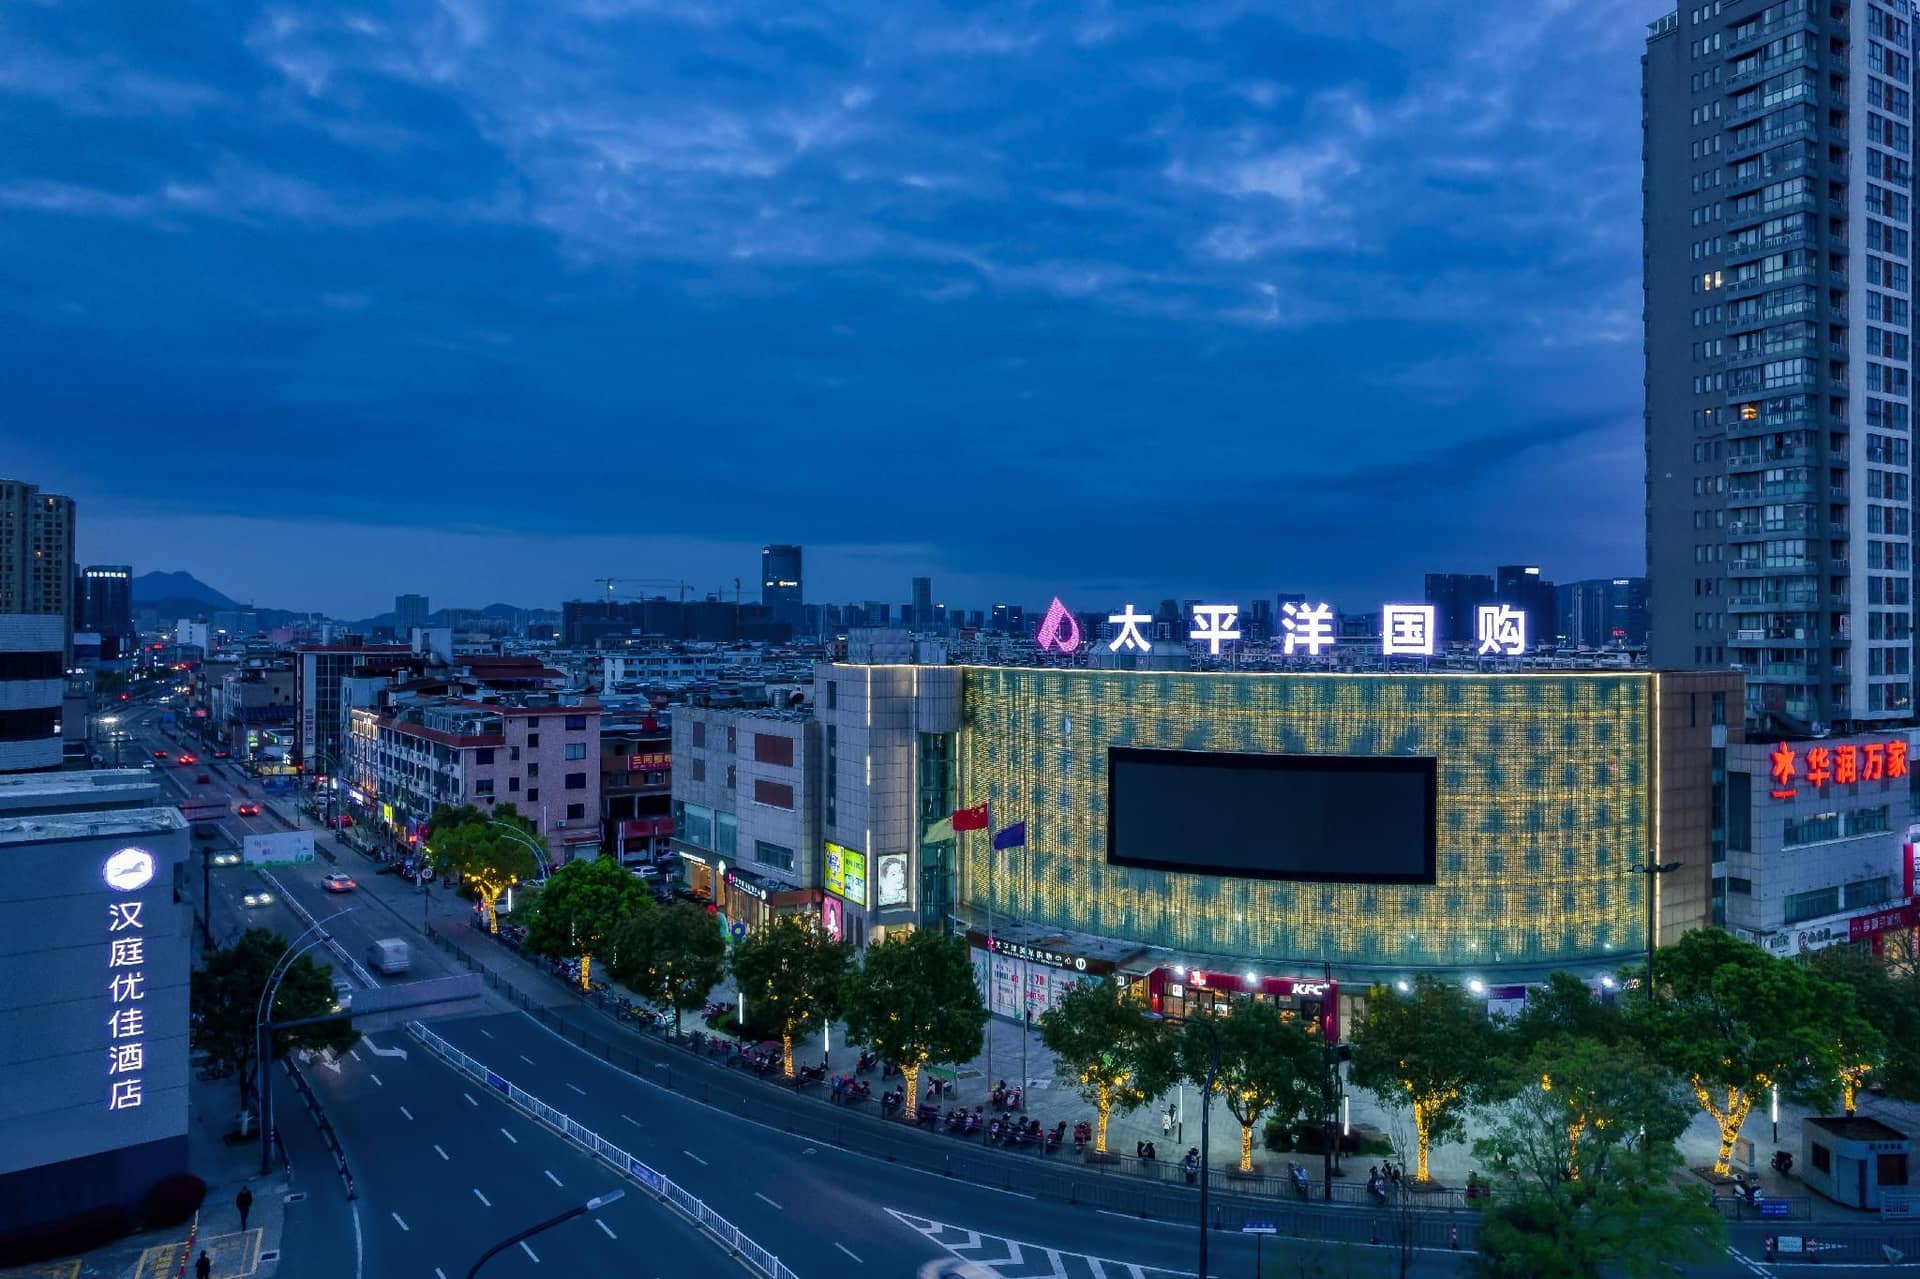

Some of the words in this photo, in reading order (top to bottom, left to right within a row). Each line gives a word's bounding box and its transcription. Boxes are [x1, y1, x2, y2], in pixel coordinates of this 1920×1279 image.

[1108, 603, 1526, 655] 太平洋国购
[1807, 740, 1908, 788] 华润万家
[108, 902, 144, 1112] 汉庭优佳酒店
[1291, 982, 1324, 996] KFC
